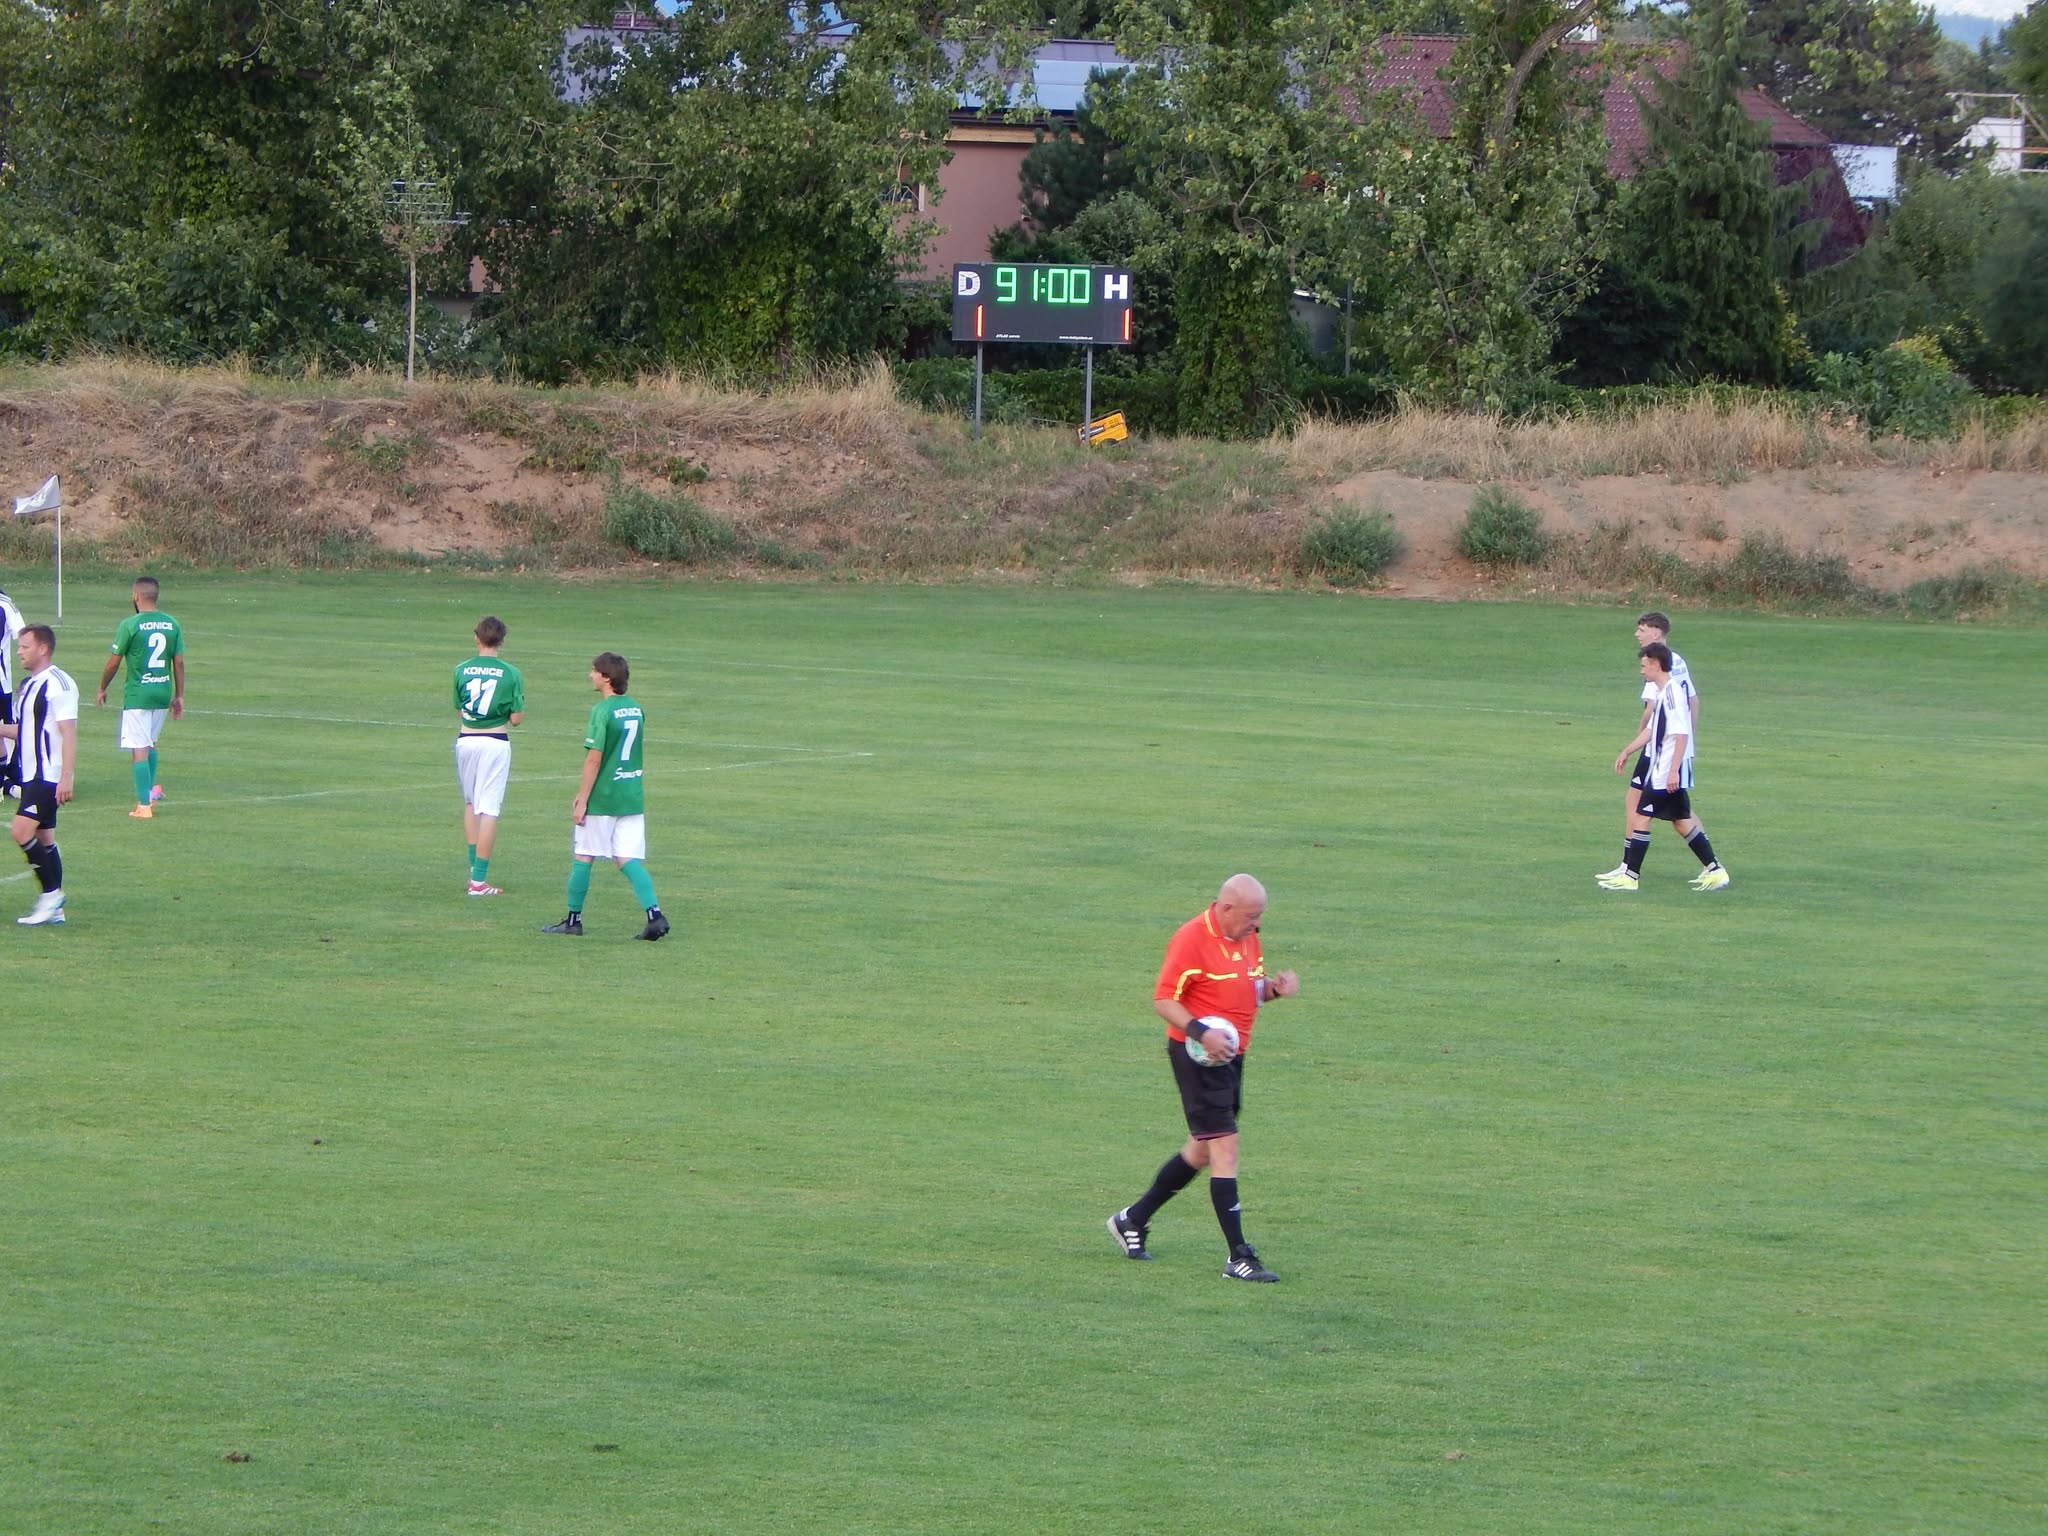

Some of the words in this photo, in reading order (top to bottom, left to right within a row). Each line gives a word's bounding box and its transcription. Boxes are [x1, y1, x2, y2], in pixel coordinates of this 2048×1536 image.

[957, 270, 981, 296] D
[1104, 274, 1129, 300] H
[976, 304, 984, 338] 1
[1123, 308, 1131, 341] 1
[139, 621, 173, 631] KONICE
[148, 632, 167, 668] 2
[463, 666, 504, 678] KONICE
[465, 678, 498, 716] 11
[621, 719, 639, 761] 7
